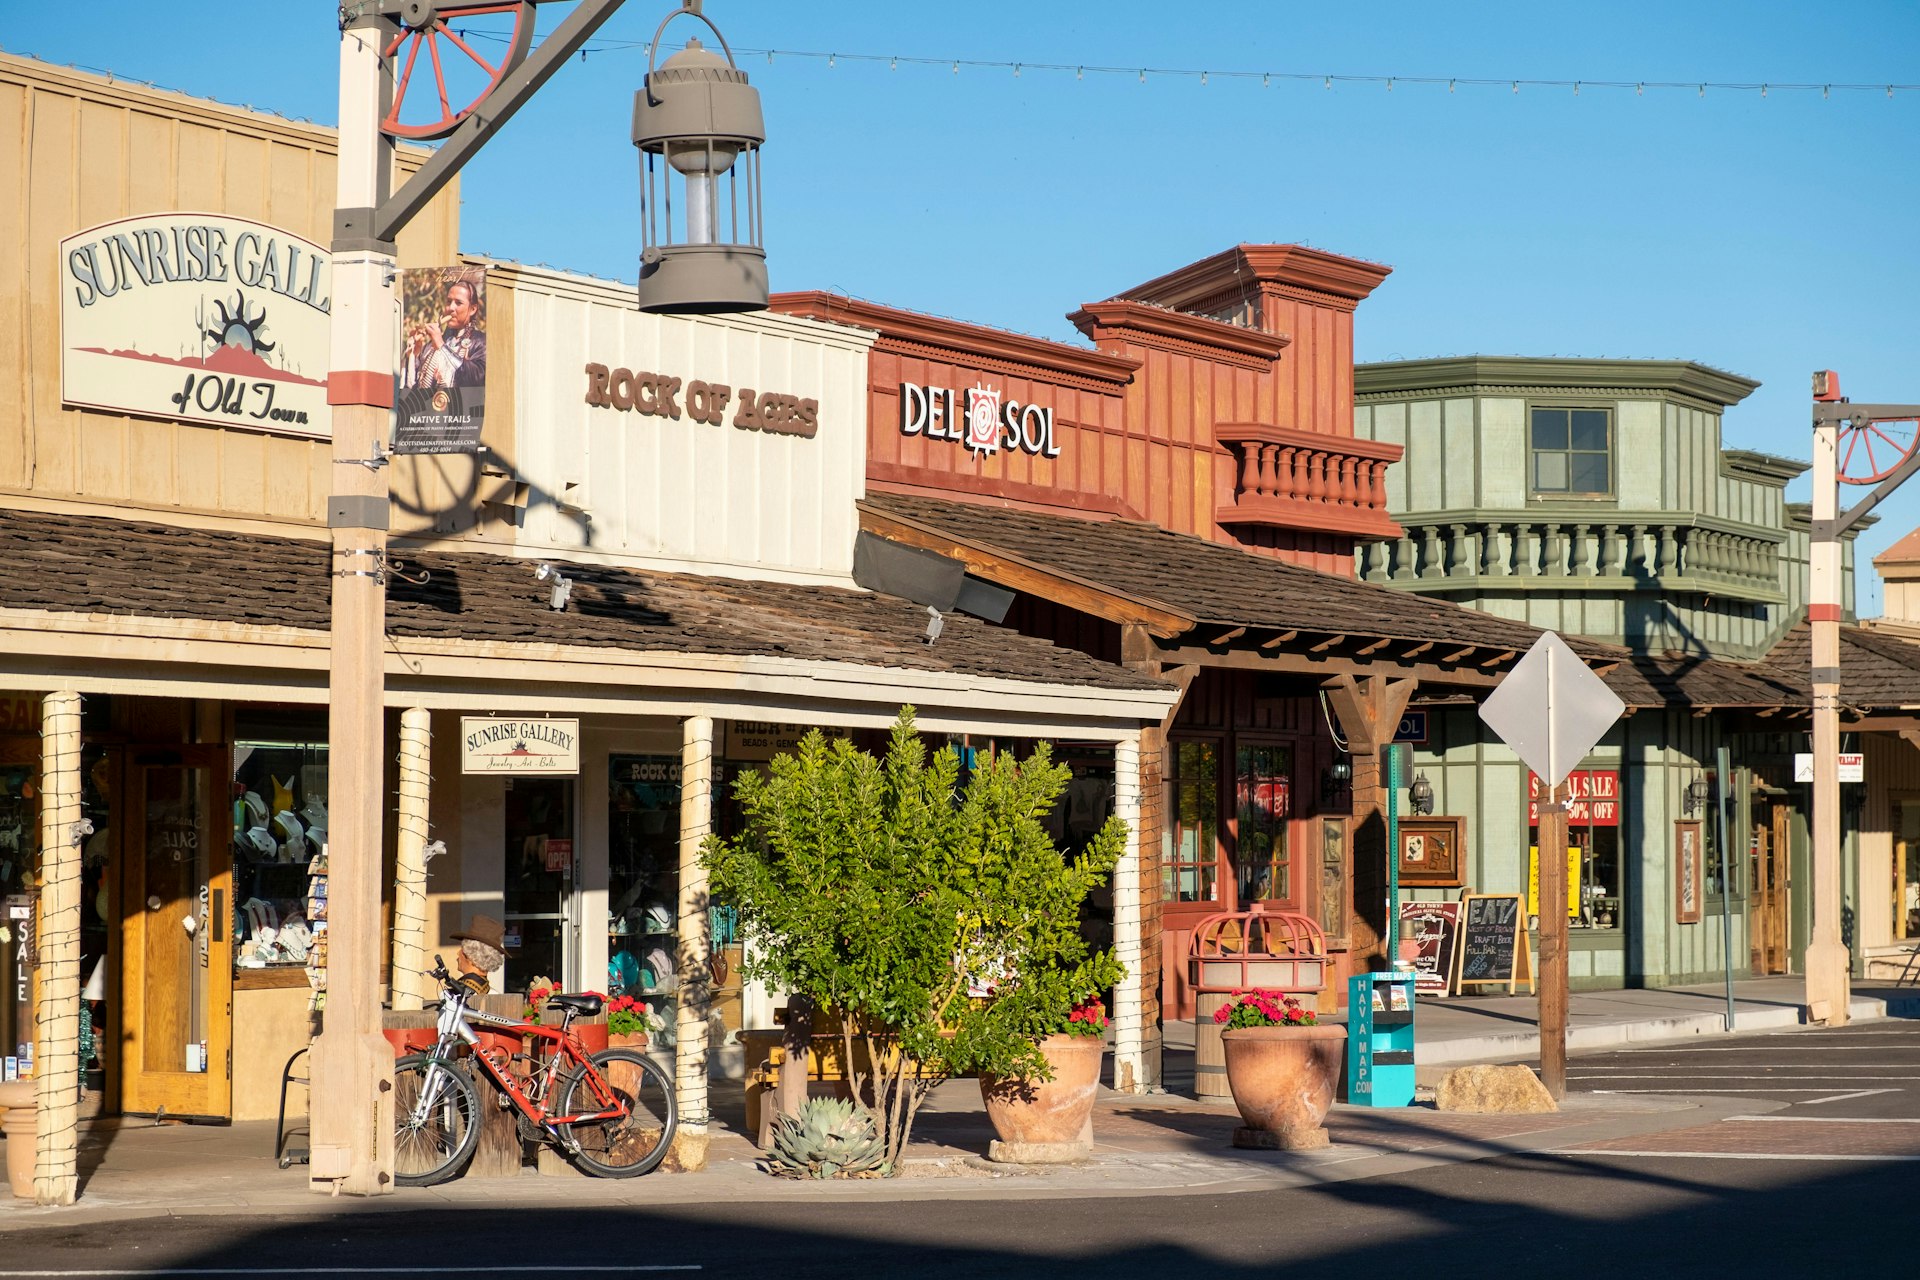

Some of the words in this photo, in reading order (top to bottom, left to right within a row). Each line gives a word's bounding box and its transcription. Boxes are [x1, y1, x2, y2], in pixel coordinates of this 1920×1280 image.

[69, 225, 229, 308] SUNRISE
[234, 231, 331, 316] GALL
[171, 373, 195, 414] of
[195, 375, 246, 416] Old
[249, 383, 309, 425] Town
[584, 362, 682, 420] ROCK
[685, 379, 731, 427] OF
[733, 388, 819, 440] AGES
[409, 415, 440, 424] NATIVE
[443, 415, 471, 424] TRAILS
[901, 382, 962, 440] DEL
[1002, 399, 1062, 457] SOL
[1399, 719, 1420, 734] OL
[467, 723, 517, 752] SUNRISE
[520, 723, 574, 751] GALLERY
[742, 738, 768, 748] BEADS
[487, 757, 513, 769] Jewelry
[631, 763, 667, 780] ROCK
[1583, 776, 1613, 796] SALE
[1594, 802, 1613, 819] OFF
[548, 852, 570, 869] OPEN
[1474, 935, 1497, 944] DRAFT
[1466, 944, 1482, 955] FULL
[1483, 944, 1497, 955] BAR
[17, 921, 29, 1001] SALE
[1375, 972, 1392, 980] FREE
[1393, 972, 1412, 980] MAPS
[1358, 1042, 1367, 1079] MAP
[480, 1048, 515, 1092] TREK
